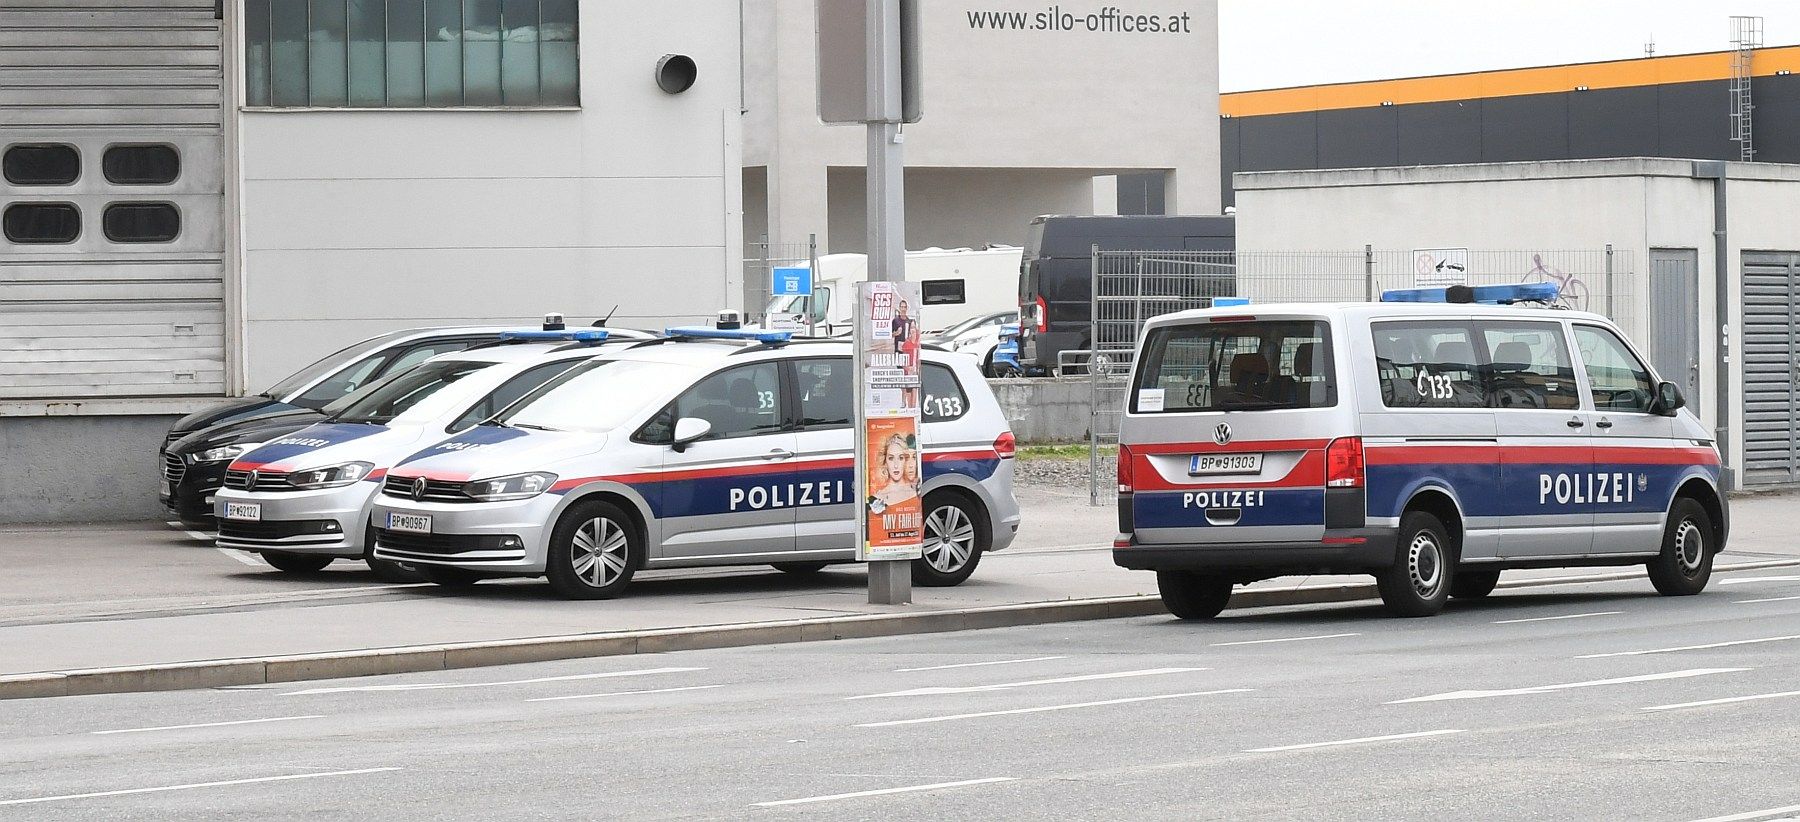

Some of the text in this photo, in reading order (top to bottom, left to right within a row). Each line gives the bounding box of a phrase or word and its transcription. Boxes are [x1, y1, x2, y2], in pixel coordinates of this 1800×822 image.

[966, 5, 1191, 34] www.silo-offices.at
[874, 294, 892, 307] SCS
[872, 306, 891, 320] RUN
[1427, 374, 1454, 399] 133
[934, 396, 963, 418] 133
[729, 480, 843, 511] POLIZEI
[1183, 490, 1264, 508] POLIZEI
[1539, 472, 1633, 504] POLIZEI
